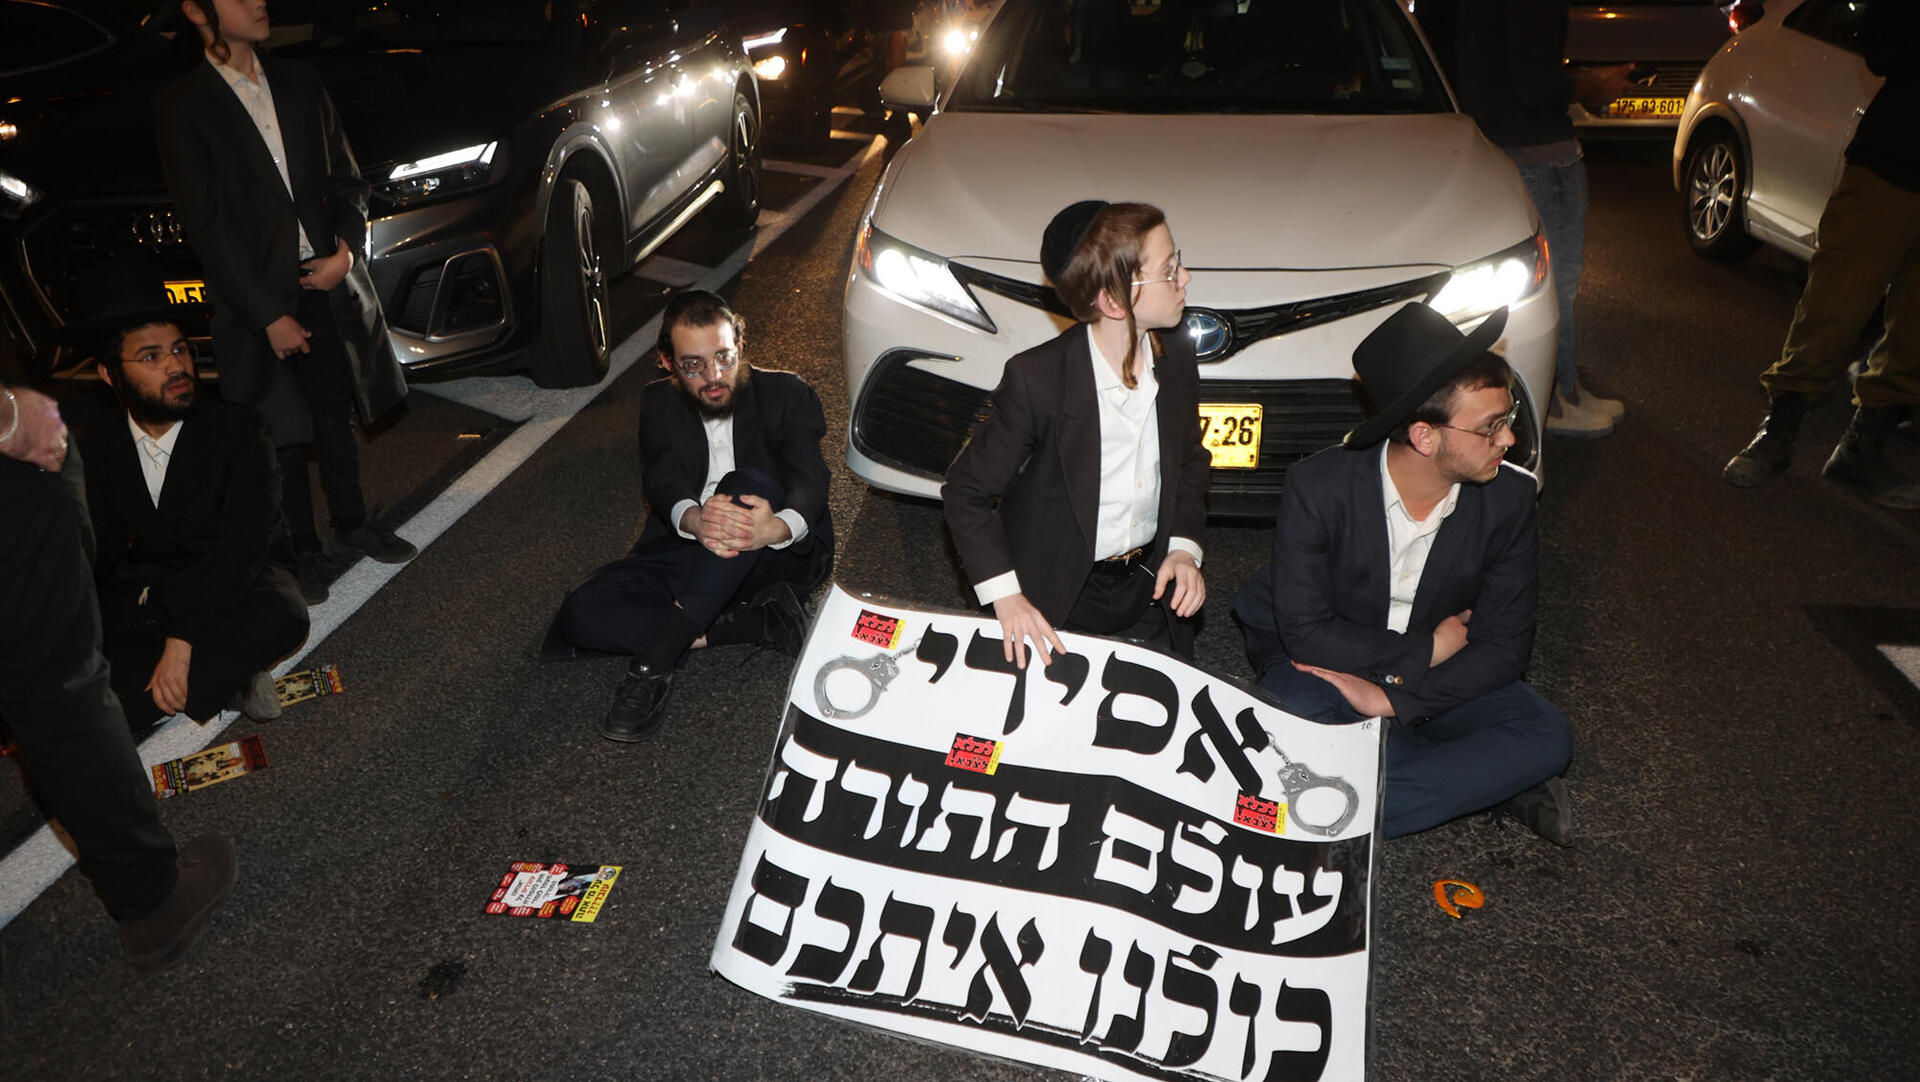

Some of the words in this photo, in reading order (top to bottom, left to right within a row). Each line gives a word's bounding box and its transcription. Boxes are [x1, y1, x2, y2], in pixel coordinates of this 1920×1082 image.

[915, 622, 1271, 795] אסירי
[767, 733, 1071, 872] התורה
[1093, 803, 1343, 946] עולם
[731, 849, 1047, 1031] איתכם
[1078, 925, 1333, 1082] כולנו
